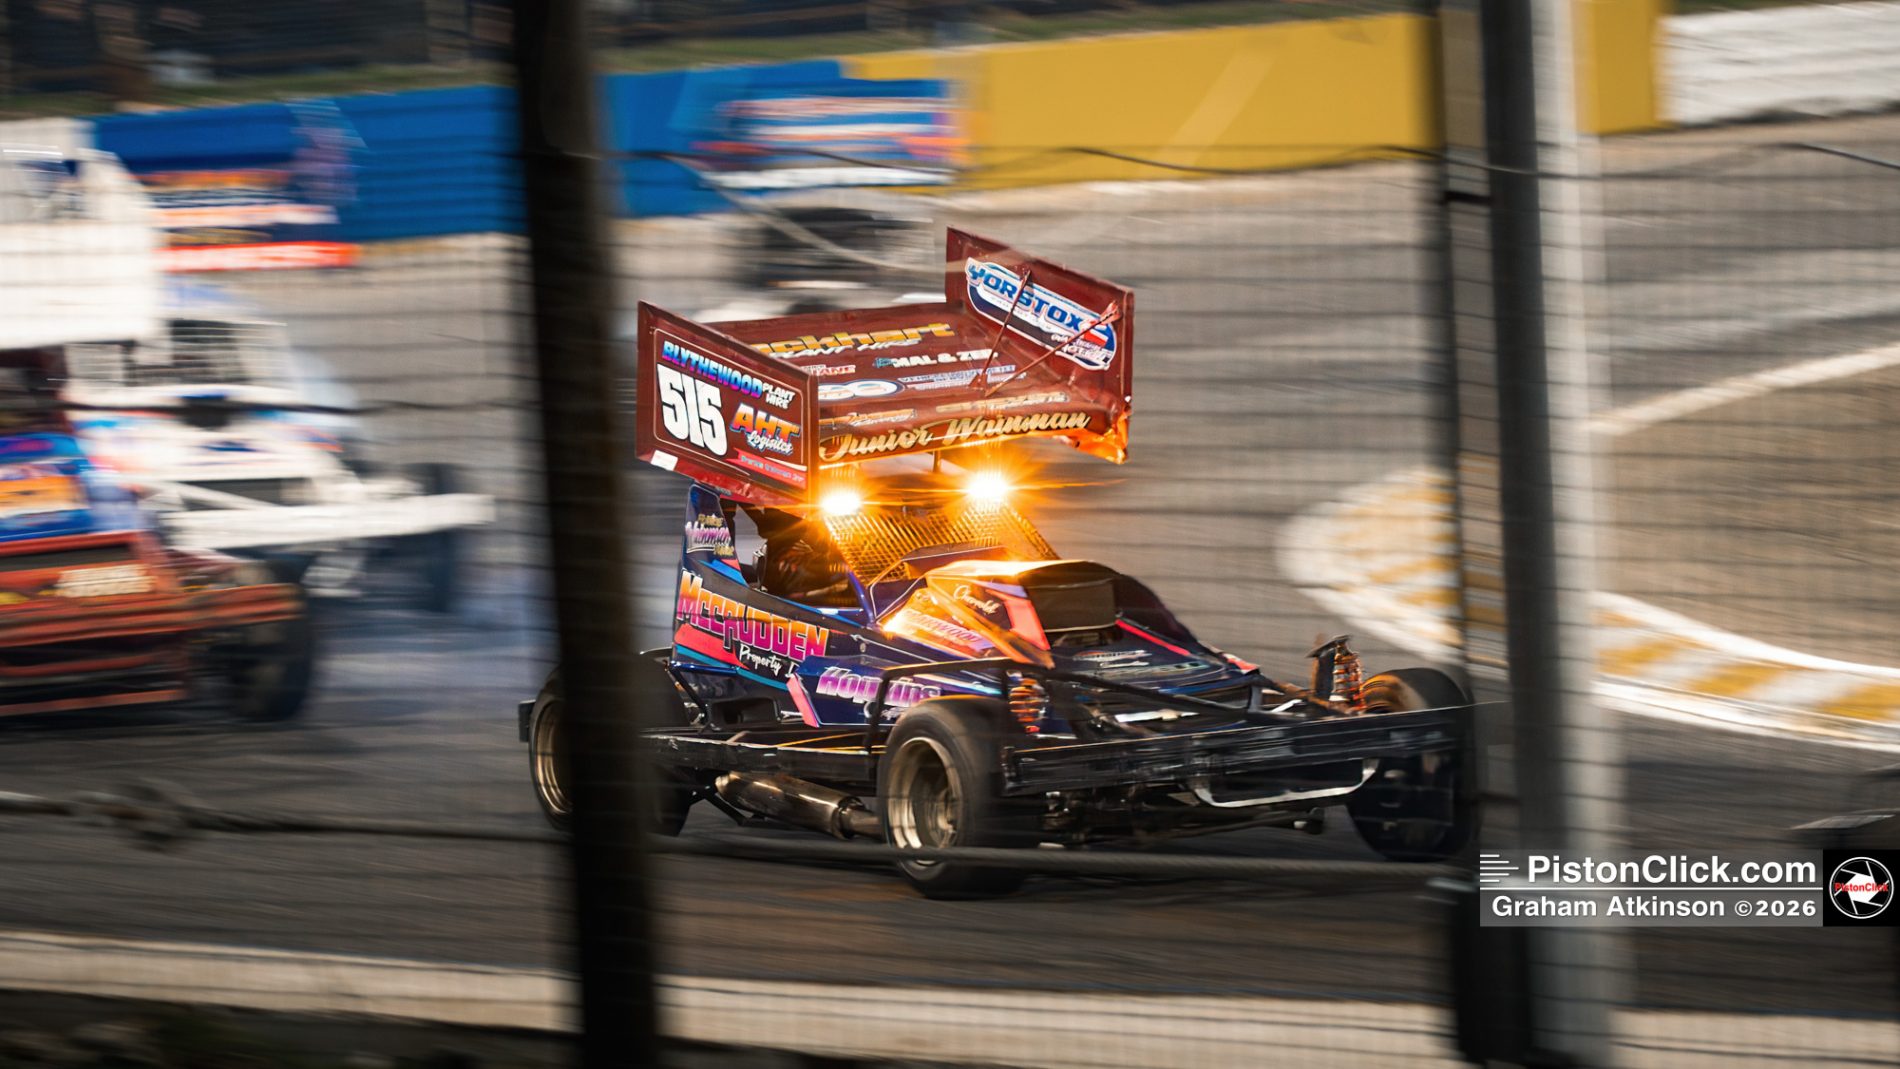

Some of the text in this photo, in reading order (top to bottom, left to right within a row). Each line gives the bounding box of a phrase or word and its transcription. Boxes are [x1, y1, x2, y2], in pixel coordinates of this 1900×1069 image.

[968, 263, 1086, 332] YORSTOX
[662, 340, 764, 399] BLYTHEWOOD
[657, 363, 728, 457] 515
[730, 402, 801, 442] AHT
[819, 427, 932, 462] Junior
[941, 411, 1092, 446] Wainman
[739, 645, 784, 676] Property
